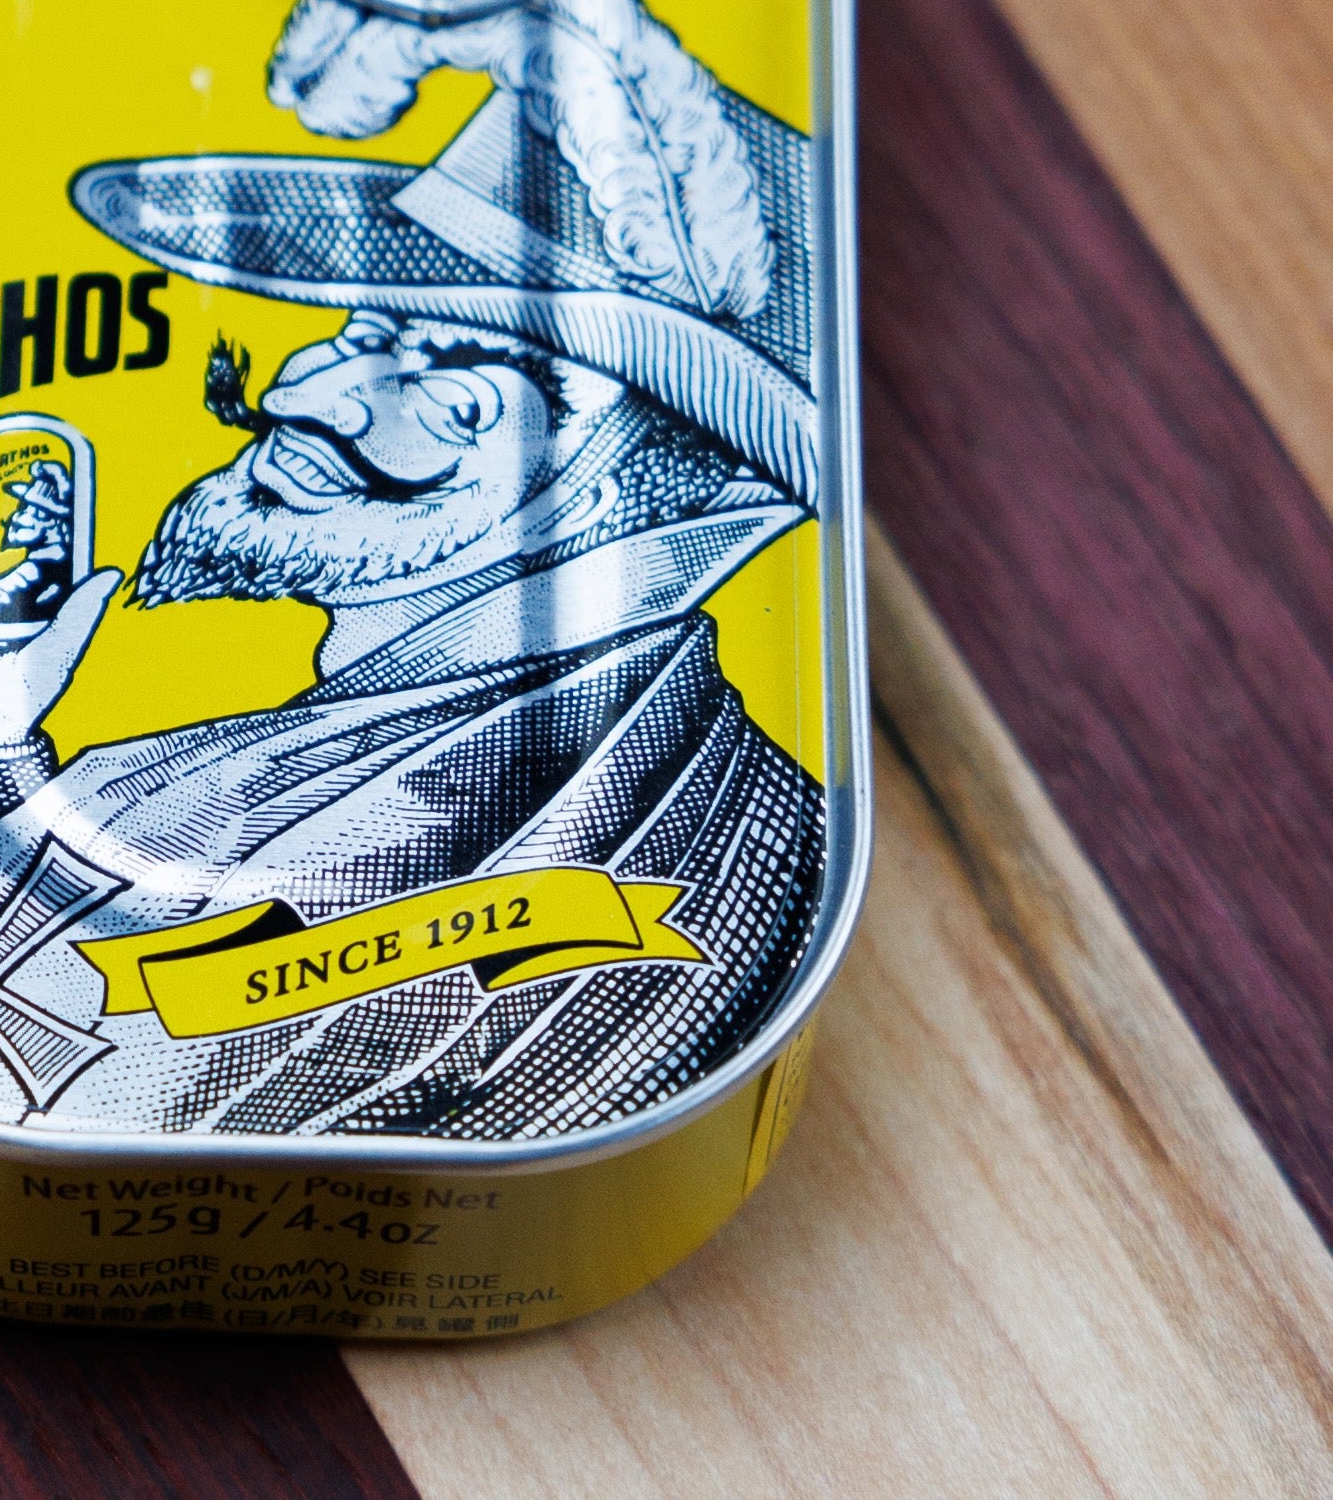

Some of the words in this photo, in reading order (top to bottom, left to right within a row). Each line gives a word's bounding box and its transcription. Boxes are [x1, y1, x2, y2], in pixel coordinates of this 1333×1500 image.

[244, 929, 403, 1004] SINCE
[424, 896, 533, 950] 1912
[22, 1174, 100, 1201] Net
[107, 1173, 259, 1203] Weight
[271, 1180, 293, 1204] /
[304, 1175, 413, 1209] Poids
[424, 1187, 503, 1210] Net
[238, 1211, 270, 1239] /
[9, 1257, 89, 1279] BEST
[99, 1254, 220, 1279] BEFORE
[359, 1268, 417, 1289] SEE
[425, 1272, 502, 1290] SIDE
[108, 1274, 213, 1299] AVANT
[341, 1283, 425, 1308] VOIR
